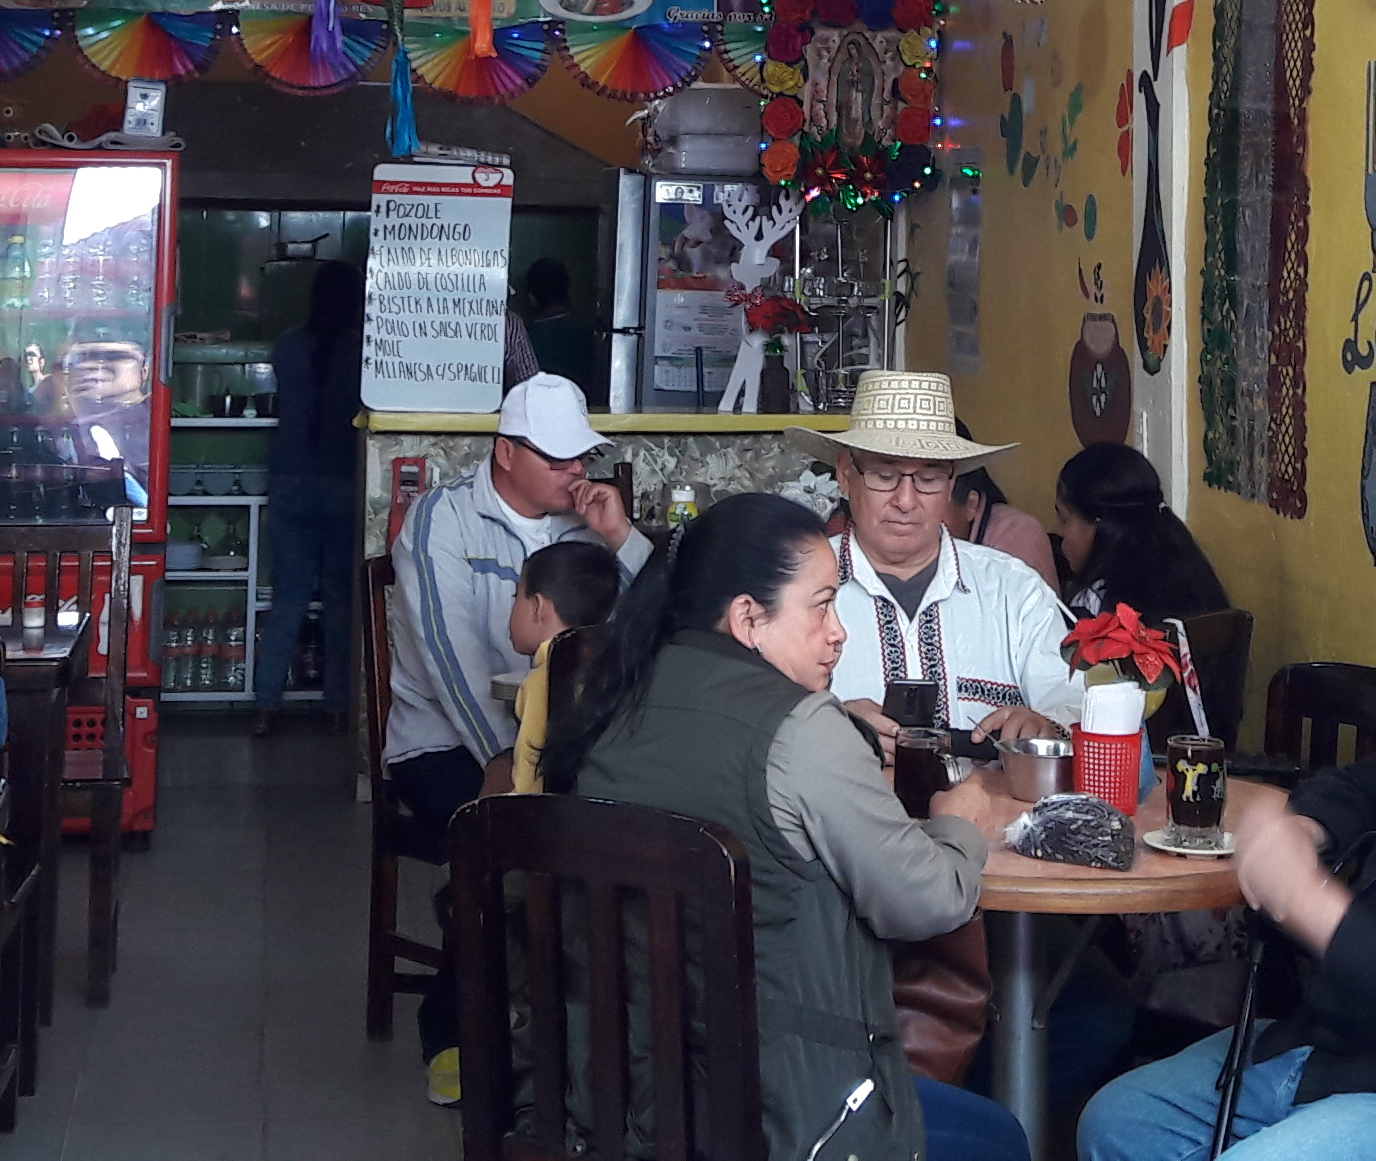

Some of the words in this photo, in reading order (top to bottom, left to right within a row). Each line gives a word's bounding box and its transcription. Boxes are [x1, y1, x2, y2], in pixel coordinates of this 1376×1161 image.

[667, 6, 723, 23] Gracias
[385, 199, 442, 220] POZOLE
[383, 223, 472, 241] MONDONGO
[378, 245, 416, 268] CALDO
[419, 247, 434, 268] DE
[437, 247, 508, 269] ALBONDIGAS
[375, 271, 412, 292] CALDO
[417, 272, 430, 292] DE
[434, 272, 487, 294] COSTILLA
[378, 294, 423, 315] BISTEK
[426, 297, 435, 316] A
[436, 297, 450, 316] LA
[452, 297, 507, 318] MEXICANA
[376, 315, 410, 338] POLLO
[413, 319, 428, 339] EN
[431, 320, 462, 339] SALSA
[465, 321, 500, 343] VERDE
[374, 338, 404, 358] MOLE
[374, 359, 434, 382] MILANESA
